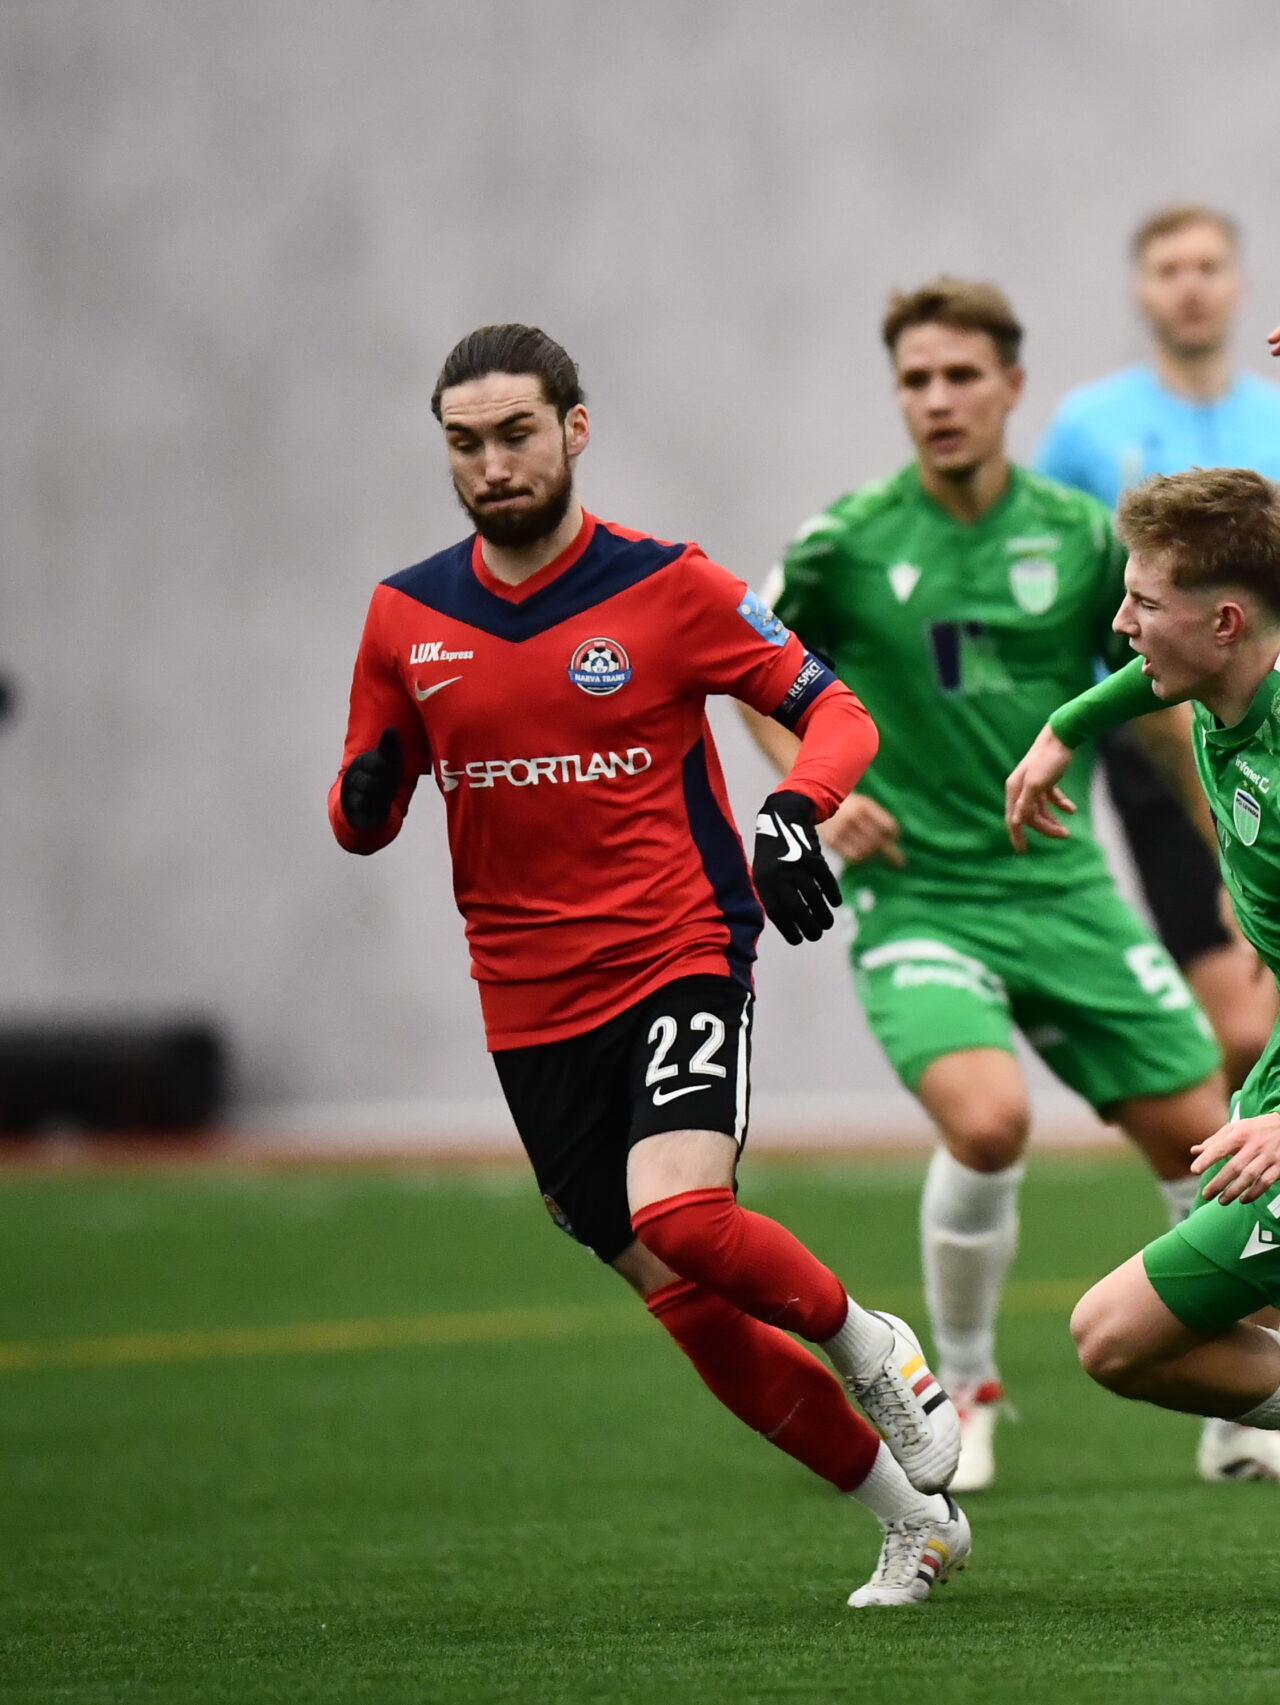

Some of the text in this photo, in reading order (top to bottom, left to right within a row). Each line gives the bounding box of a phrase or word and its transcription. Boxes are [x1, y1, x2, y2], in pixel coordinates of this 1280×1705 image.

[409, 641, 444, 665] LUX
[788, 661, 822, 698] RESPECT
[464, 747, 653, 789] SPORTLAND
[1123, 943, 1193, 1012] 5
[645, 1011, 727, 1088] 22
